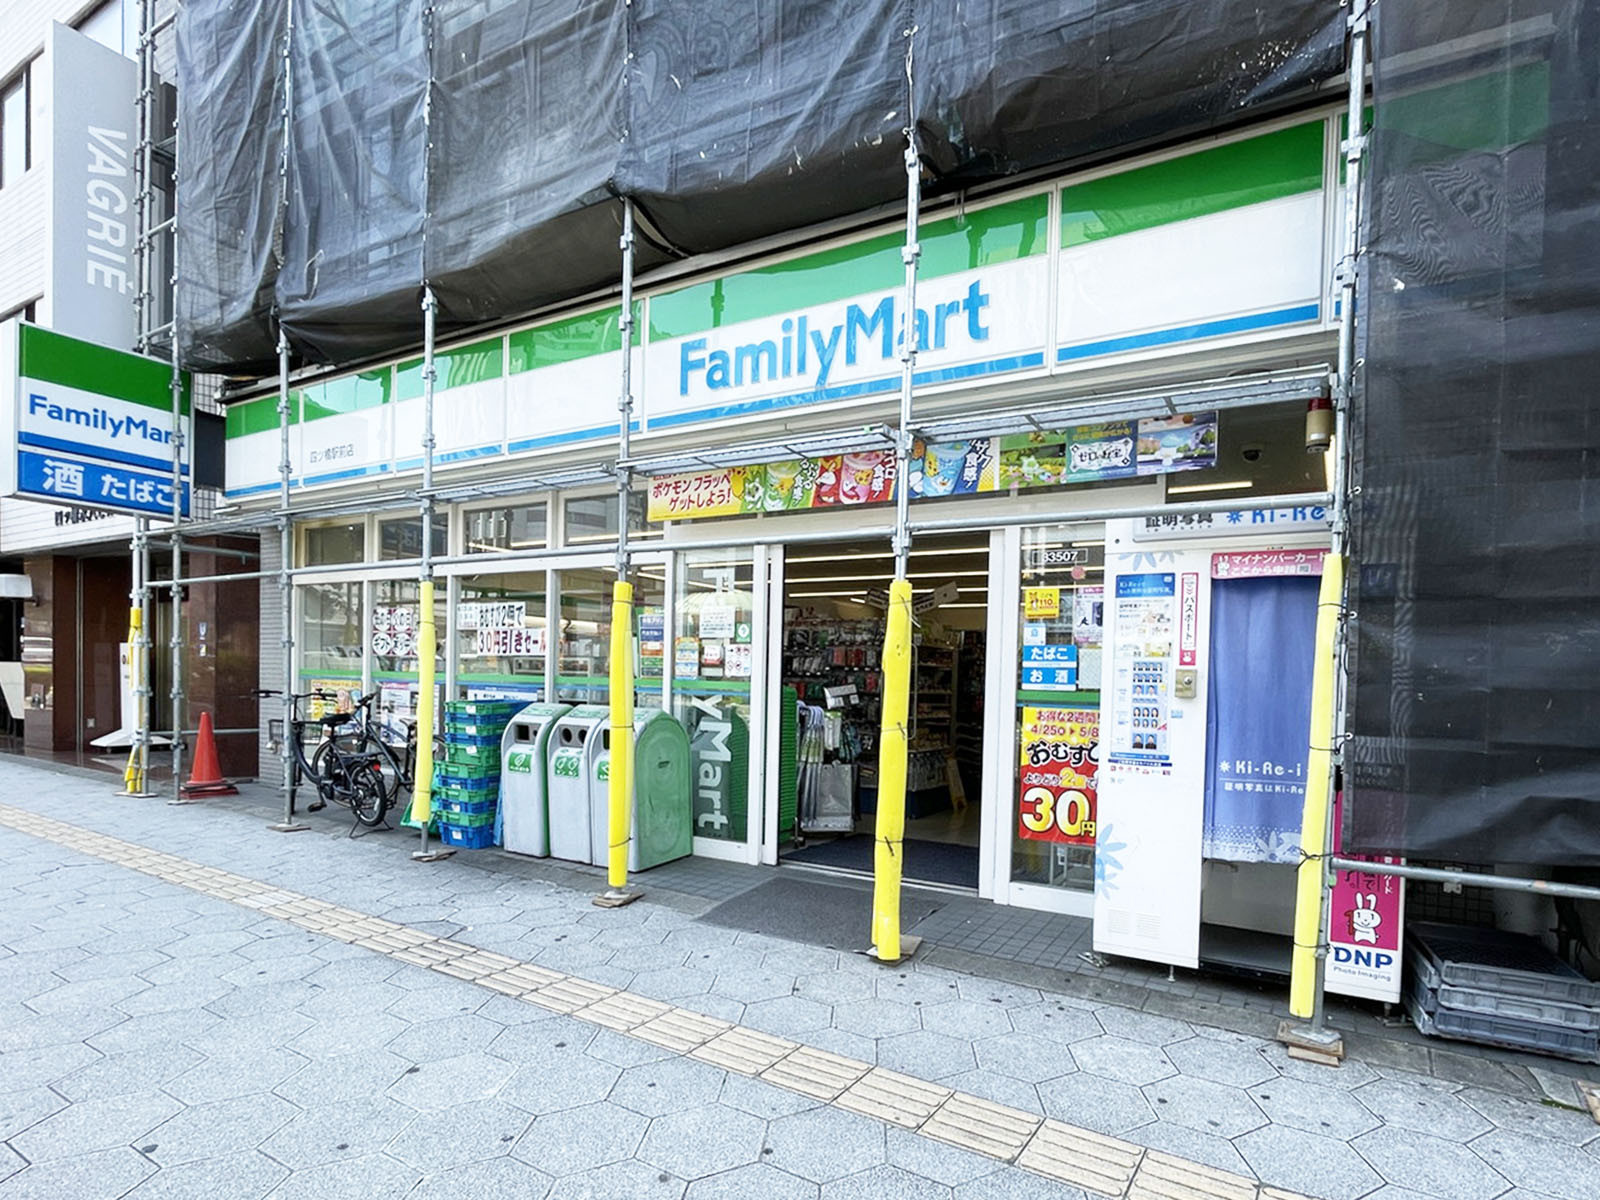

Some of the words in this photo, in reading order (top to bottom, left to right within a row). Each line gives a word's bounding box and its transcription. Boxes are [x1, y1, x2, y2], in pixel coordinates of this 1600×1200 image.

[680, 279, 989, 397] FamilyMart
[42, 459, 85, 496] 酒
[101, 473, 184, 507] たばこ
[1031, 646, 1069, 660] たばこ
[1334, 946, 1393, 969] DNP
